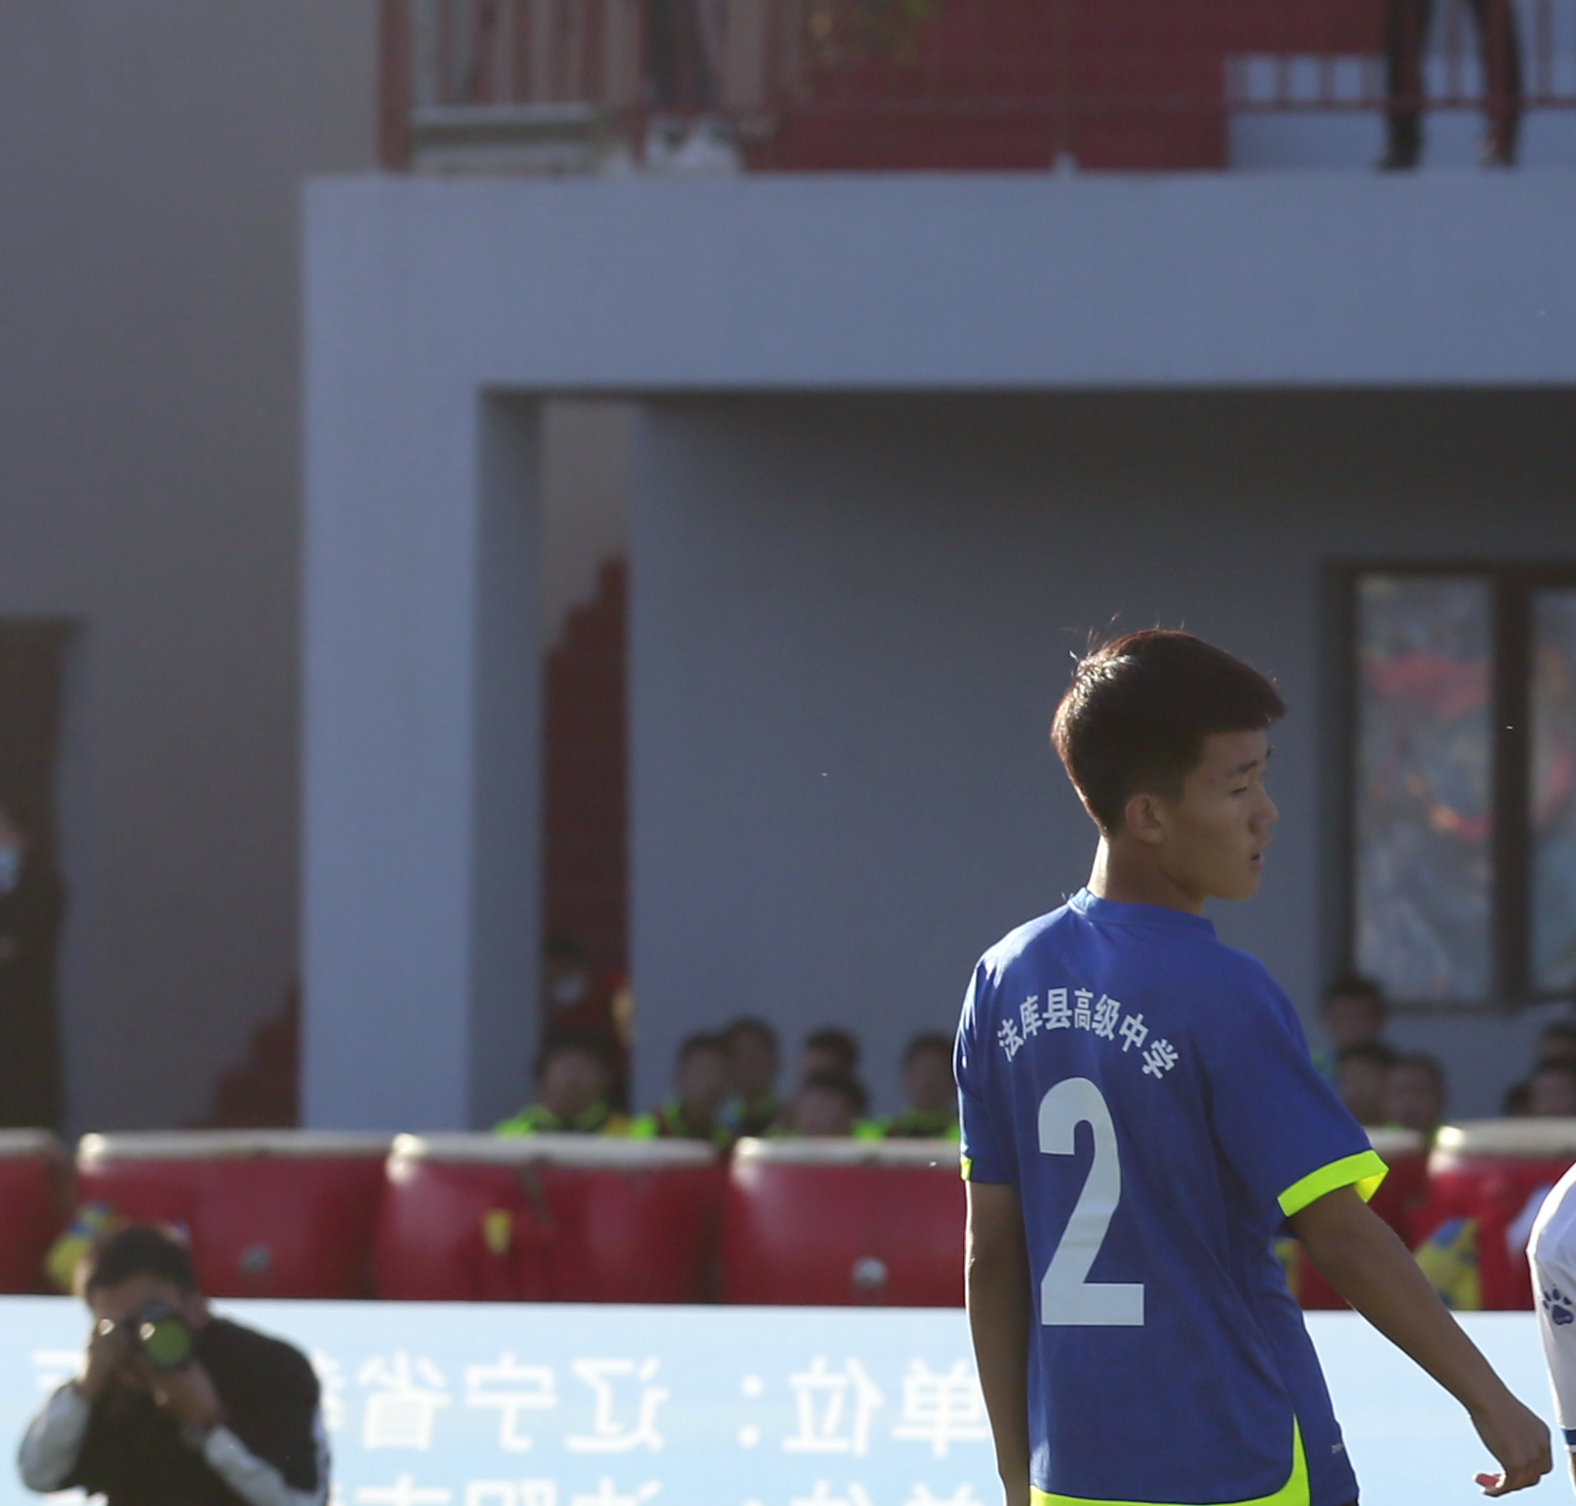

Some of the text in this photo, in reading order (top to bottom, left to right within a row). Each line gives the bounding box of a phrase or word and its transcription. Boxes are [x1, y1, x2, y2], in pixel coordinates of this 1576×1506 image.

[997, 987, 1179, 1079] 法库县高级中学
[1037, 1077, 1145, 1326] 2
